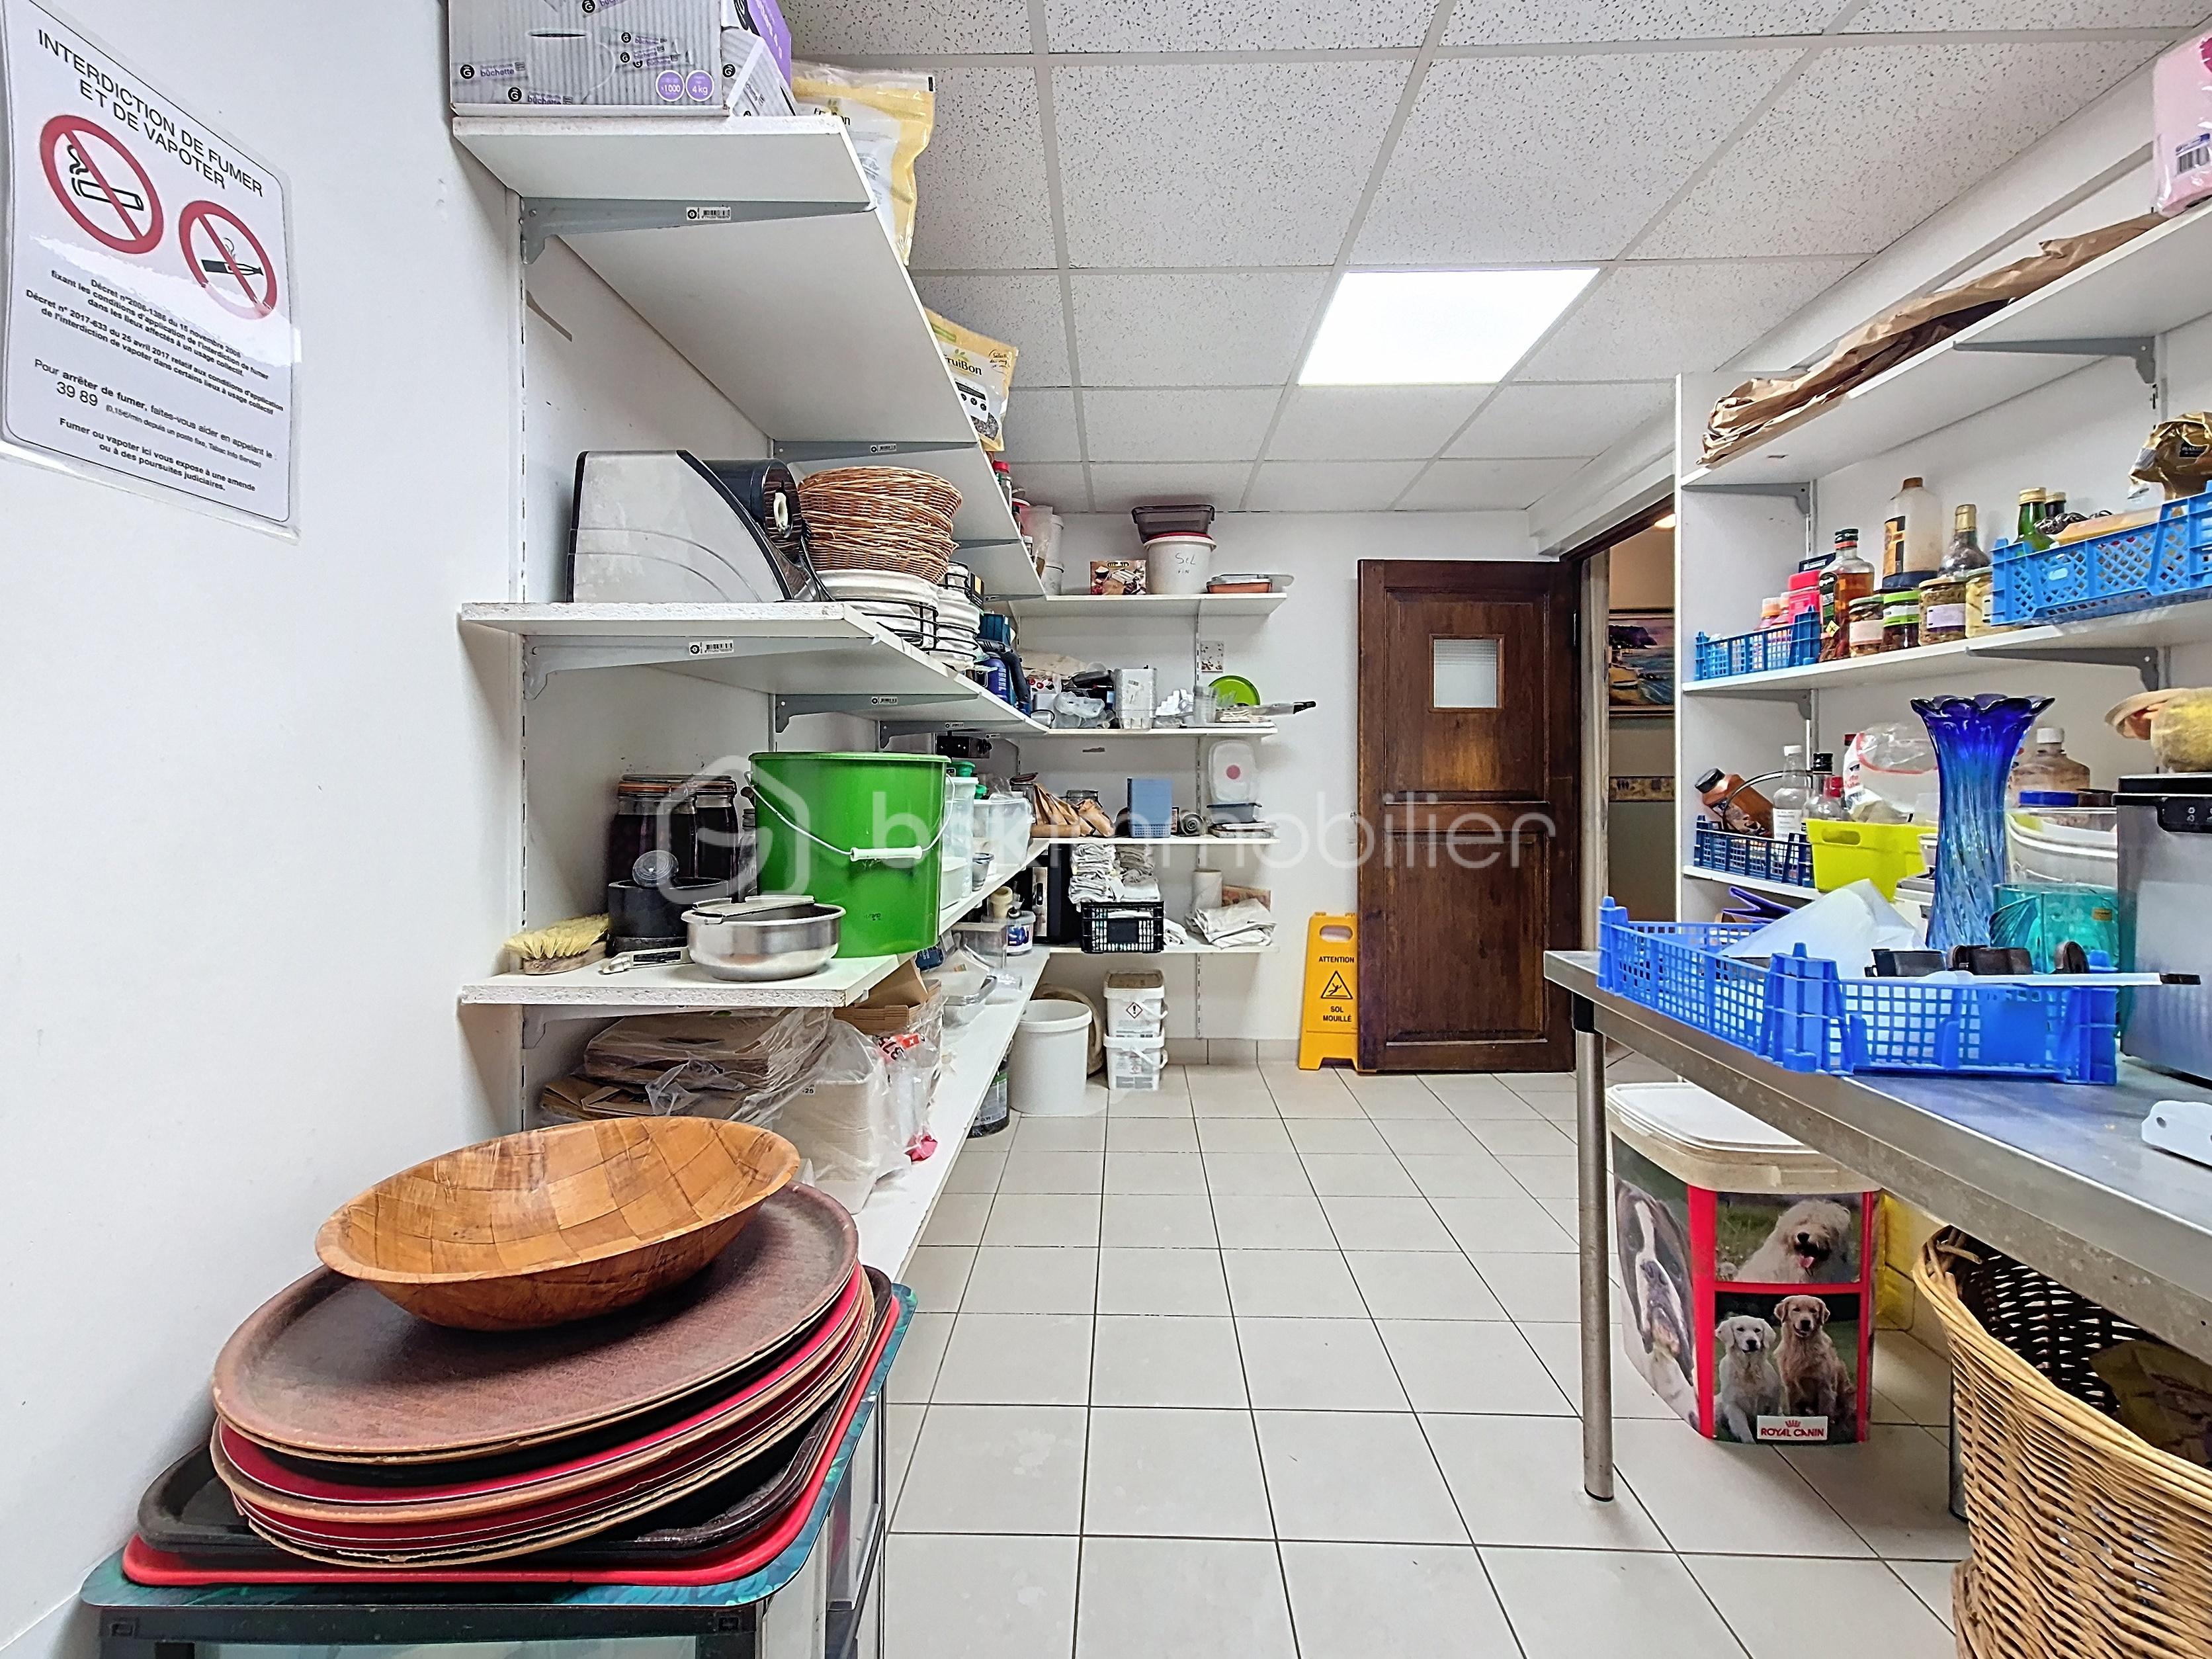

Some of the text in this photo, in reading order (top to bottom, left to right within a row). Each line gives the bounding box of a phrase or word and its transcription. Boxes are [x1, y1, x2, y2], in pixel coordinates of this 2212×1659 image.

[38, 29, 263, 197] INTERDICTION DE FUMER
[80, 79, 225, 190] ET DE VAPOTER
[26, 289, 56, 309] Décret
[70, 310, 108, 331] 2017-633
[109, 328, 120, 337] du
[122, 333, 132, 343] 25
[133, 339, 150, 351] avril
[152, 347, 170, 359] 2017
[194, 366, 206, 376] aux
[208, 373, 243, 393] conditions
[51, 270, 77, 288] fixant
[78, 282, 91, 294] les
[93, 292, 136, 316] conditions
[187, 337, 196, 345] de
[87, 298, 108, 313] dans
[110, 308, 122, 319] les
[124, 314, 143, 329] lieux
[145, 325, 175, 344] affectés
[183, 343, 192, 352] un
[193, 349, 215, 363] usage
[91, 278, 118, 298] Décret
[168, 318, 178, 327] du
[180, 323, 188, 332] 15
[189, 329, 224, 350] novembre
[41, 308, 52, 318] de
[54, 314, 108, 342] l'interdiction
[110, 338, 120, 347] de
[122, 343, 152, 361] vapoter
[153, 358, 172, 370] dans
[173, 367, 202, 384] certains
[228, 390, 247, 404] usage
[34, 359, 60, 375] Pour
[62, 371, 99, 390] arrêter
[101, 386, 114, 396] de
[116, 392, 148, 411] fumer,
[150, 405, 196, 429] faites-vous
[198, 425, 218, 438] aider
[220, 434, 231, 443] en
[232, 438, 264, 456] appelant
[266, 450, 273, 459] le
[56, 381, 75, 398] 39
[79, 390, 98, 407] 89
[60, 417, 90, 434] Fumer
[92, 431, 104, 440] ou
[106, 435, 140, 452] vapoter
[153, 452, 174, 464] vous
[176, 459, 204, 474] expose
[212, 472, 226, 481] une
[228, 477, 255, 491] amende
[99, 443, 111, 452] ou
[121, 450, 136, 461] des
[139, 456, 182, 476] poursuites
[184, 471, 226, 491] judiciaires.
[1760, 1427, 1824, 1437] ROYAL CANIN
